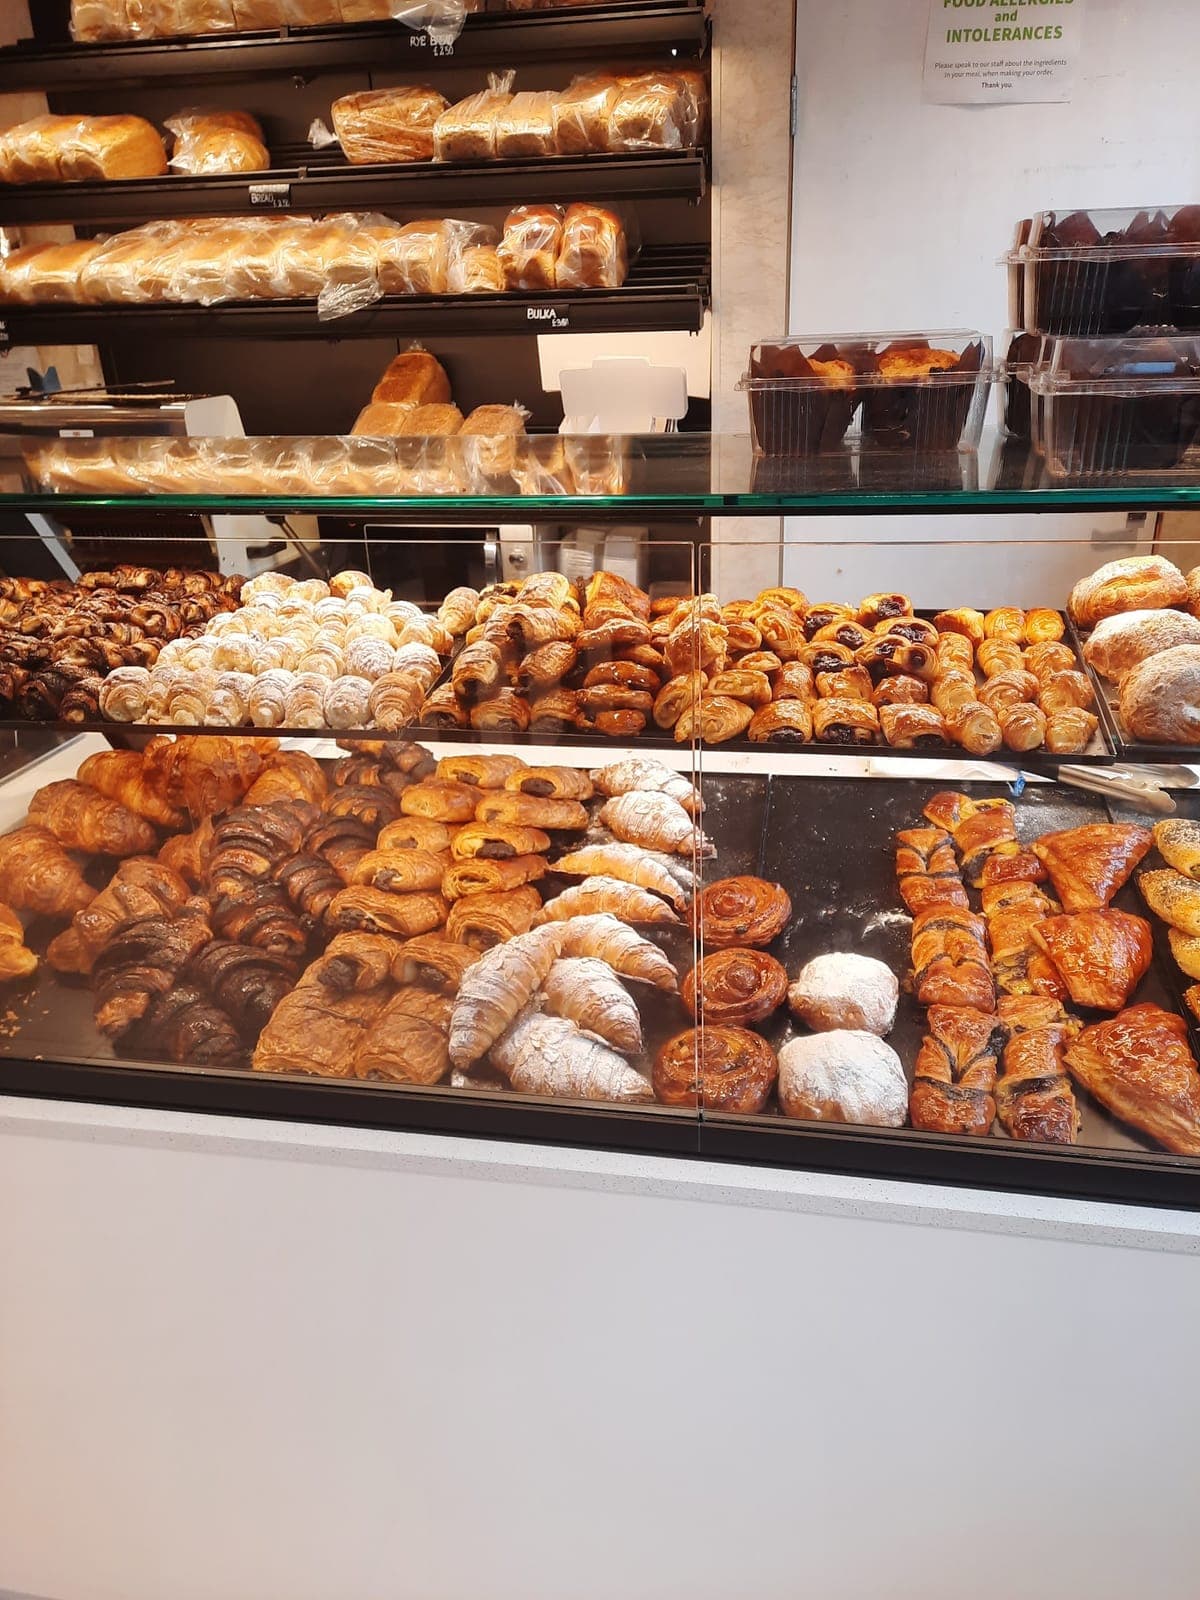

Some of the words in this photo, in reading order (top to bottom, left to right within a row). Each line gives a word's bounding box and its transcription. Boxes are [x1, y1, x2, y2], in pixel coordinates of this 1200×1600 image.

[994, 10, 1018, 22] and
[946, 25, 1063, 43] INTOLERANCES
[409, 35, 427, 47] RYE
[955, 61, 971, 70] speak
[1034, 58, 1067, 68] ingredients
[999, 69, 1021, 77] making
[527, 307, 557, 320] BULKA
